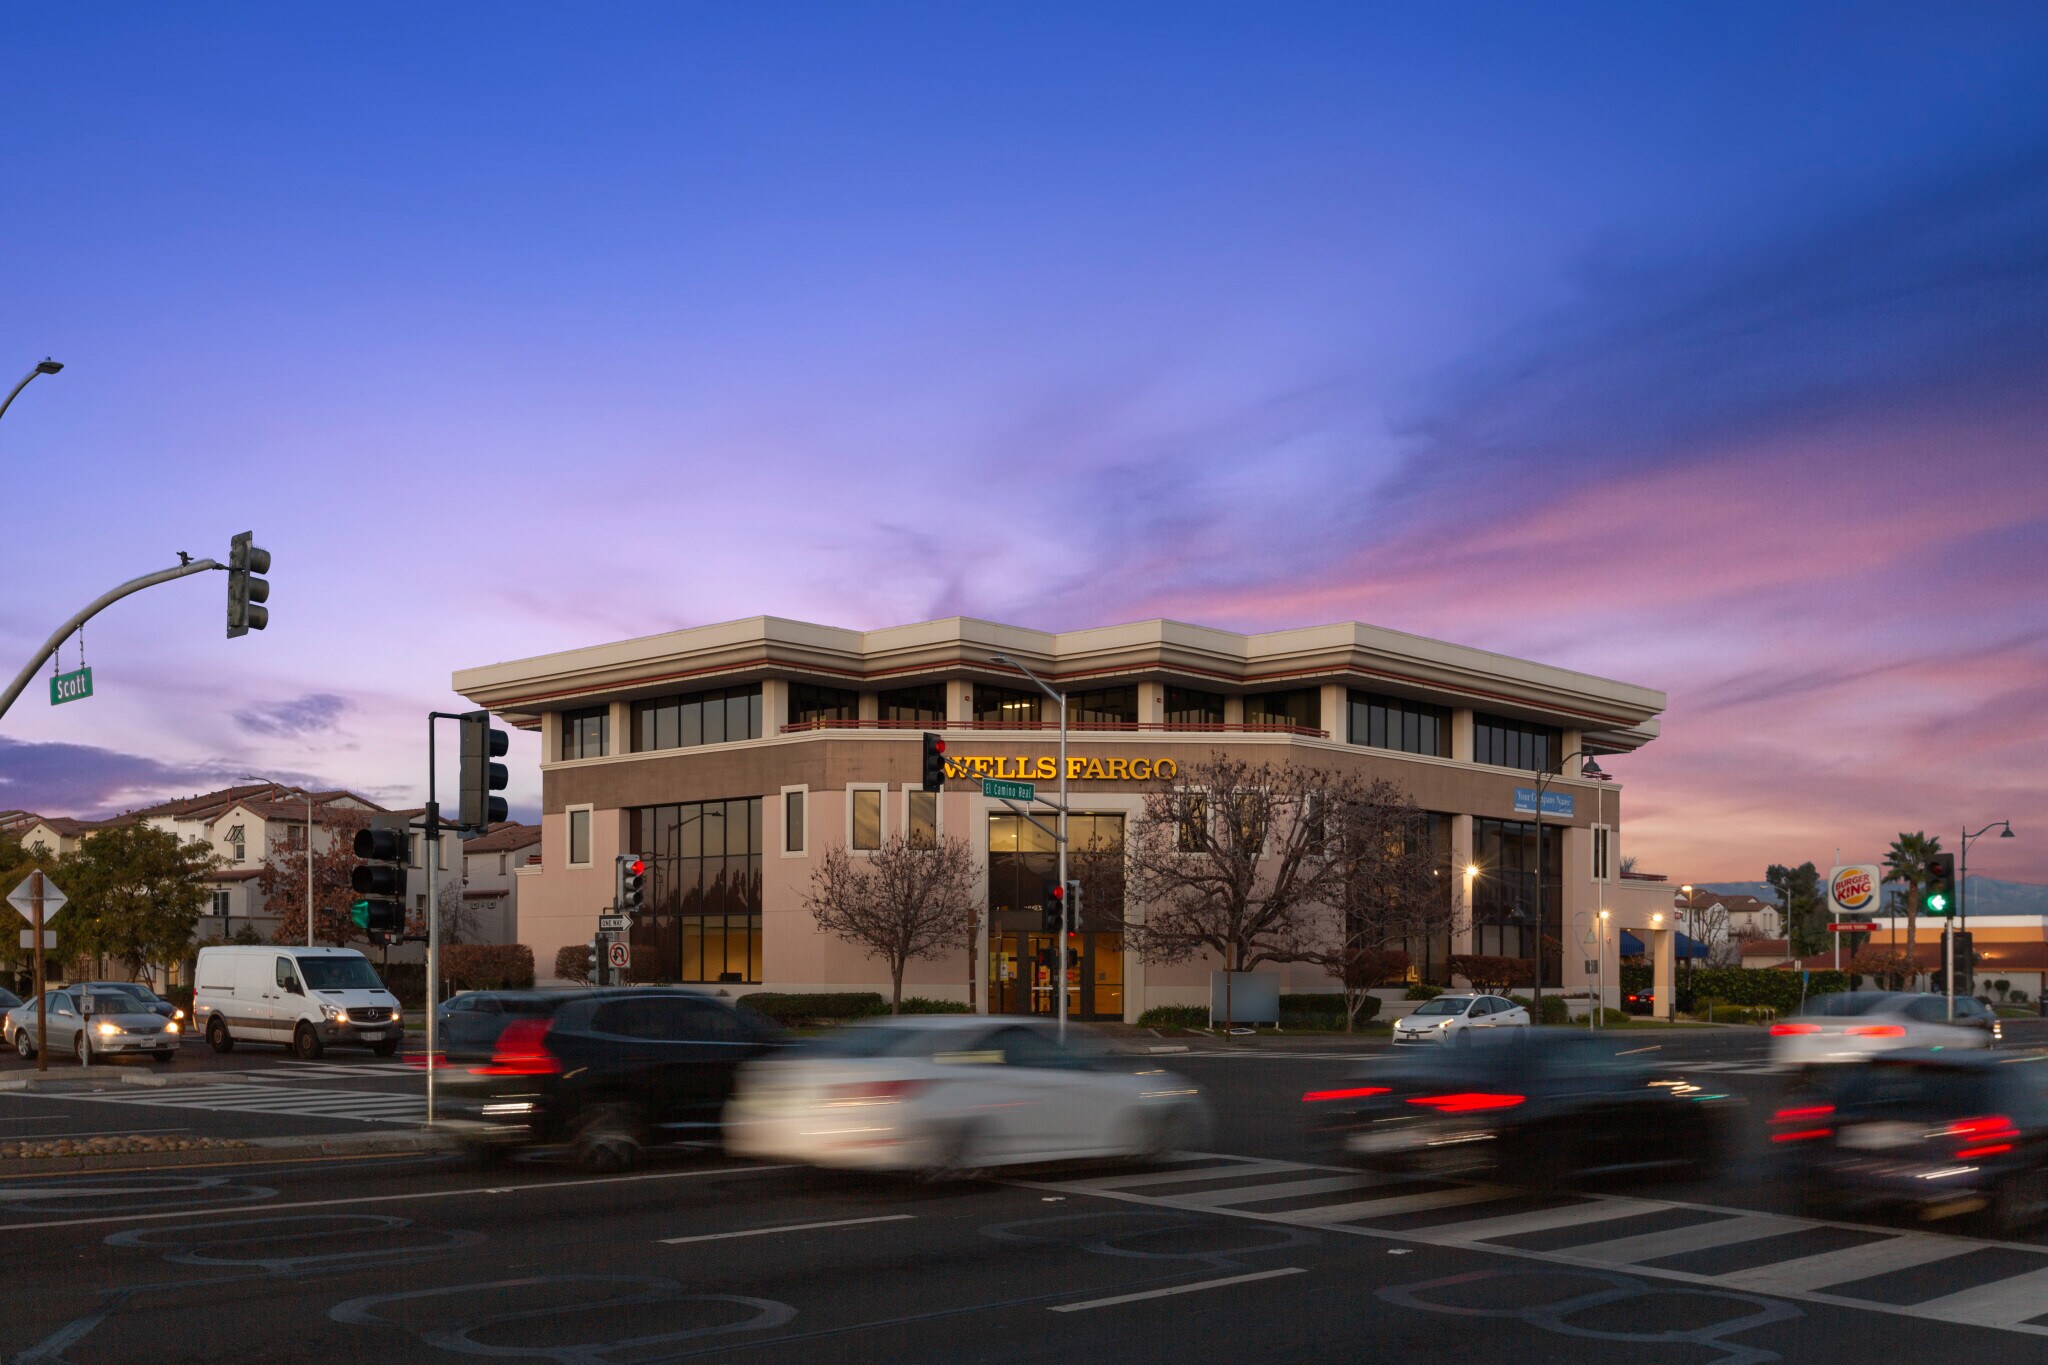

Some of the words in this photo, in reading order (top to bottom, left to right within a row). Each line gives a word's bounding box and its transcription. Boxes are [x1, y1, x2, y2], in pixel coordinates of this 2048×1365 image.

[58, 674, 86, 699] Scott
[944, 756, 1057, 779] WELLS
[1065, 757, 1177, 780] FARGO
[985, 782, 991, 794] El
[993, 784, 1015, 797] Camino
[1018, 786, 1031, 799] Real
[1835, 874, 1870, 891] BURGER
[1837, 882, 1872, 902] KING
[602, 919, 612, 927] ONE
[613, 919, 623, 927] WAY
